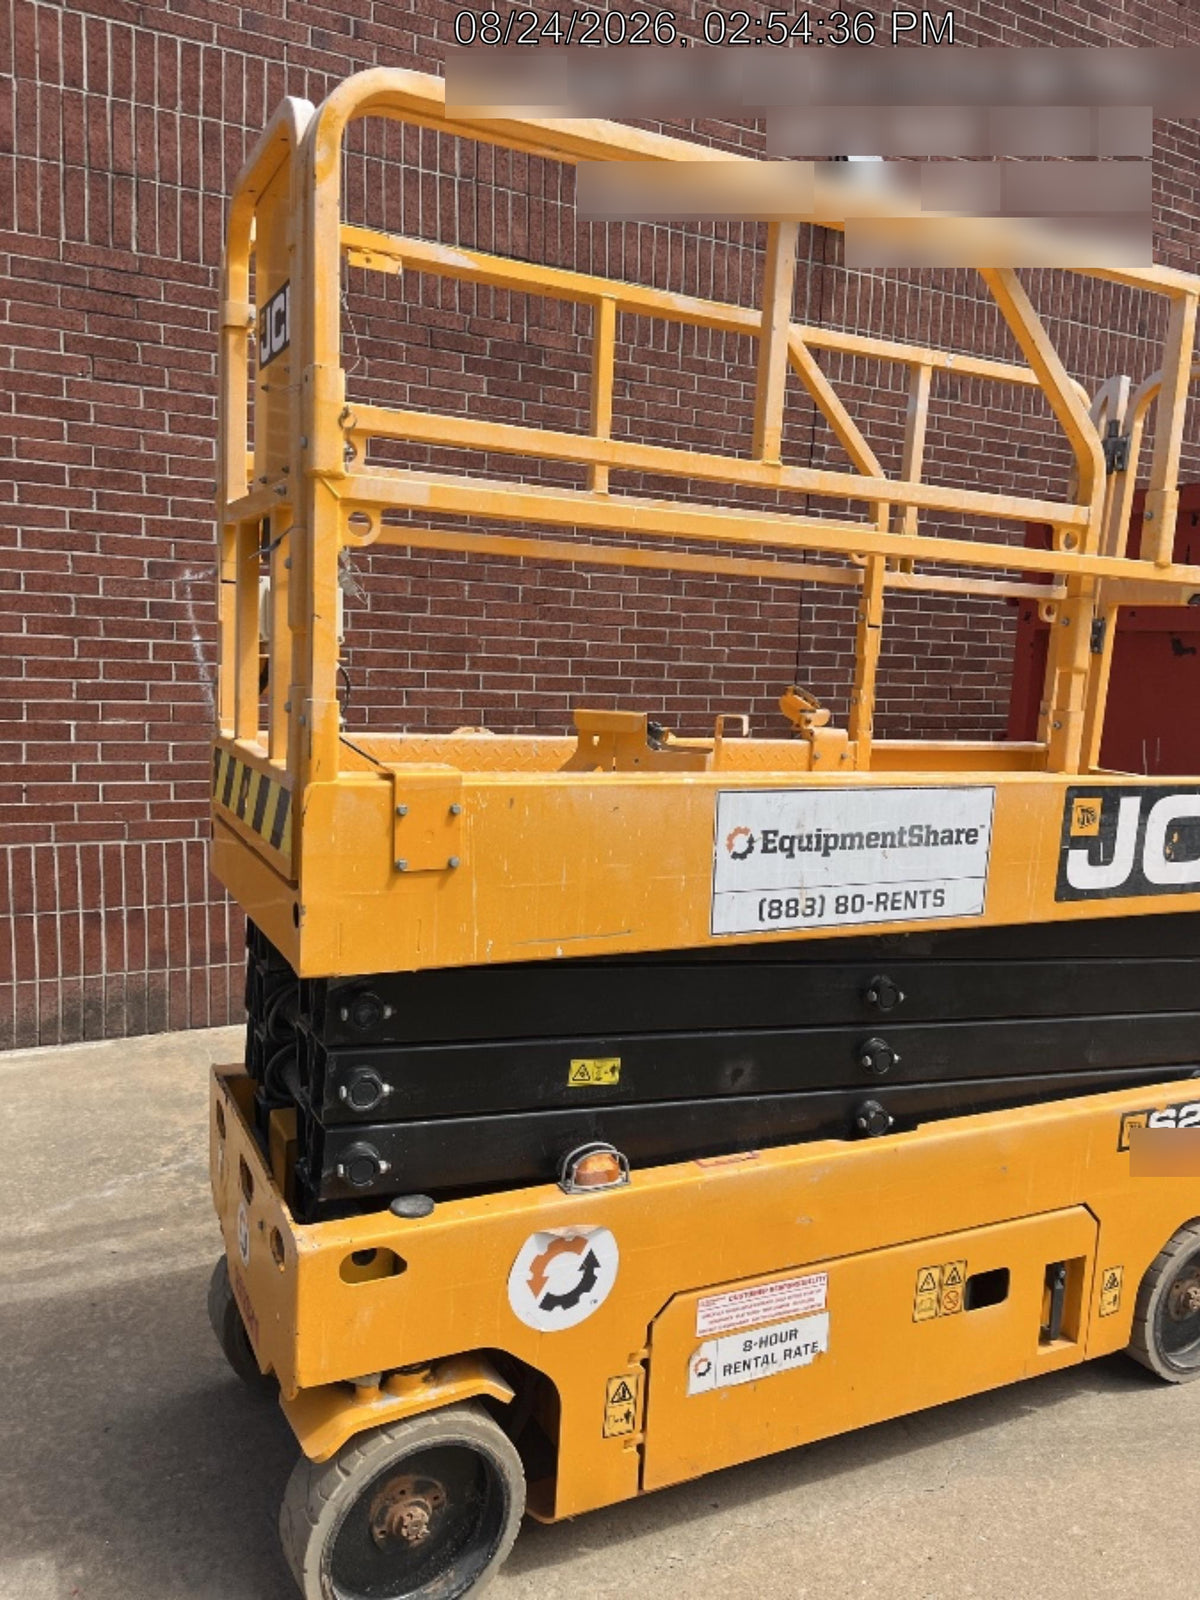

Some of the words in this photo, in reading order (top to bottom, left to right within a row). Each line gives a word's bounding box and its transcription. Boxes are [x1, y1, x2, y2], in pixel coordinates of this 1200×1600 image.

[760, 824, 979, 858] EquipmentShare
[835, 889, 945, 915] 80-RENTS
[742, 1328, 798, 1352] 8-HOUR
[723, 1352, 777, 1377] RENTAL
[783, 1341, 819, 1361] RATE
